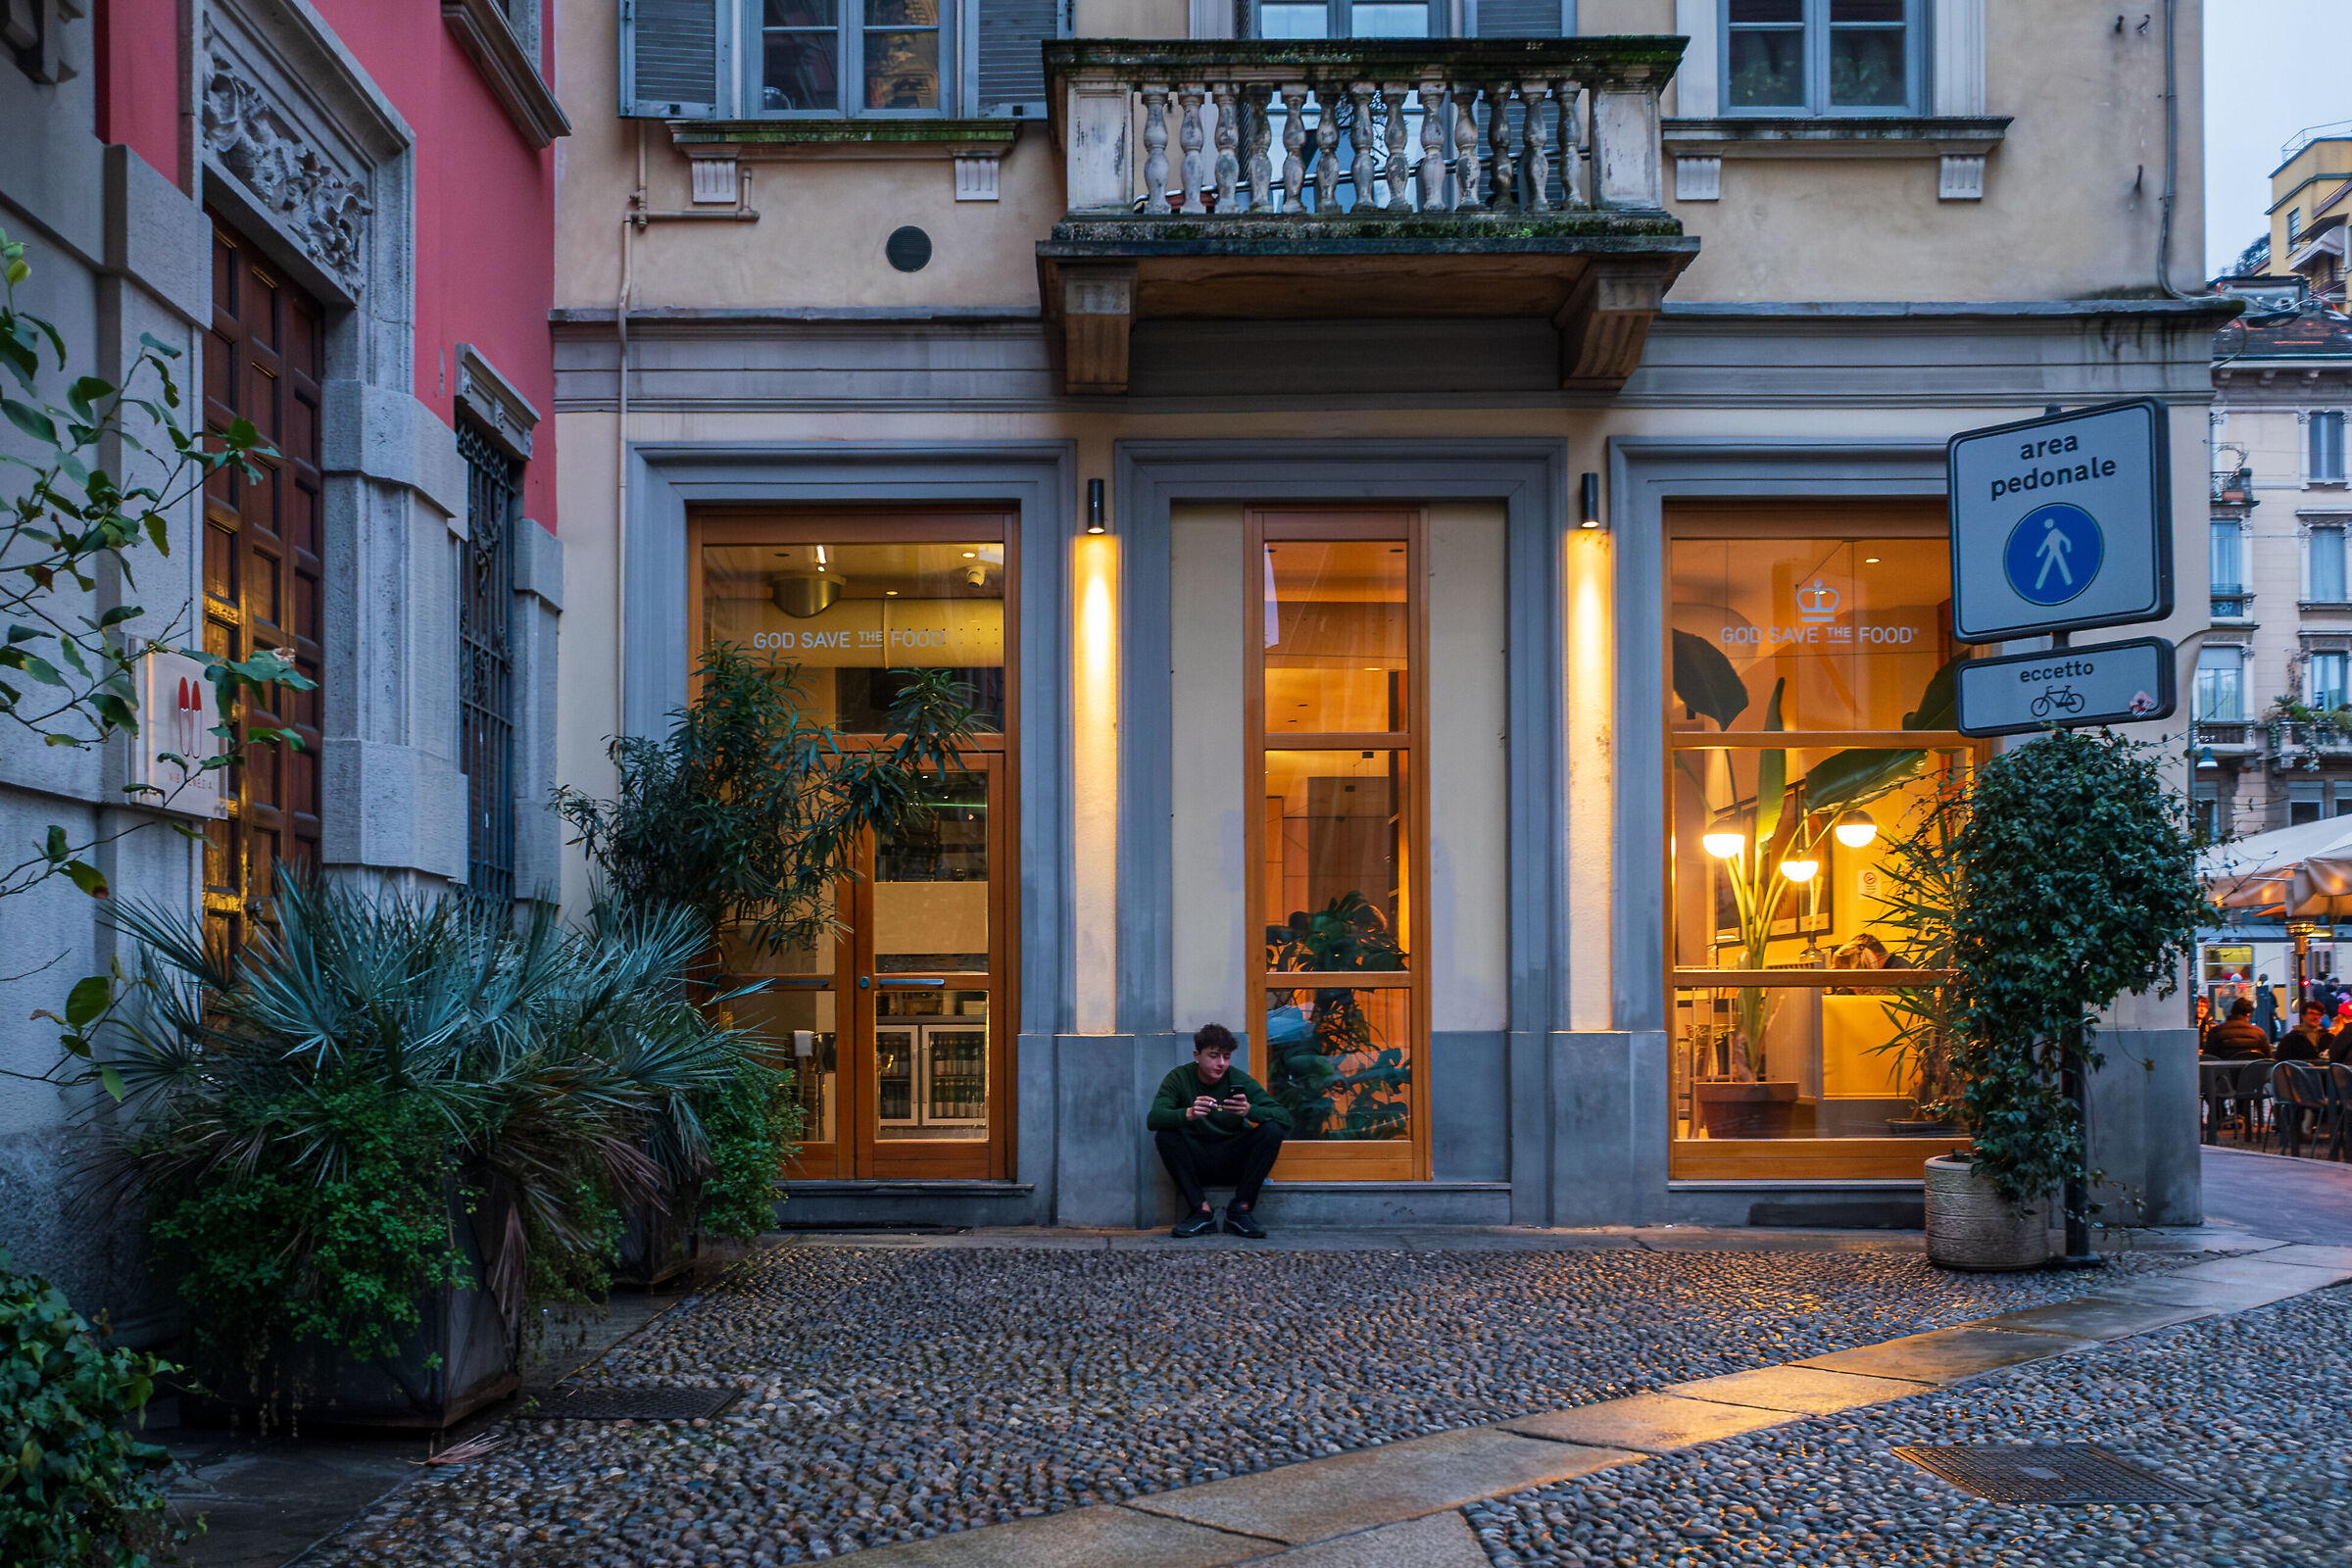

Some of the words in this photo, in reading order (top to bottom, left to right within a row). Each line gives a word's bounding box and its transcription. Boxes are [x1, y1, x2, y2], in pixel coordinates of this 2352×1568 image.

[2020, 434, 2079, 461] area
[1990, 456, 2117, 501] pedonale
[753, 632, 796, 650] GOD
[801, 631, 851, 649] SAVE
[858, 630, 883, 643] THE
[890, 630, 944, 648] FOOD
[1720, 626, 1763, 644] GOD
[1769, 626, 1819, 644] SAVE
[1827, 626, 1851, 639] THE
[2020, 660, 2095, 683] eccetto
